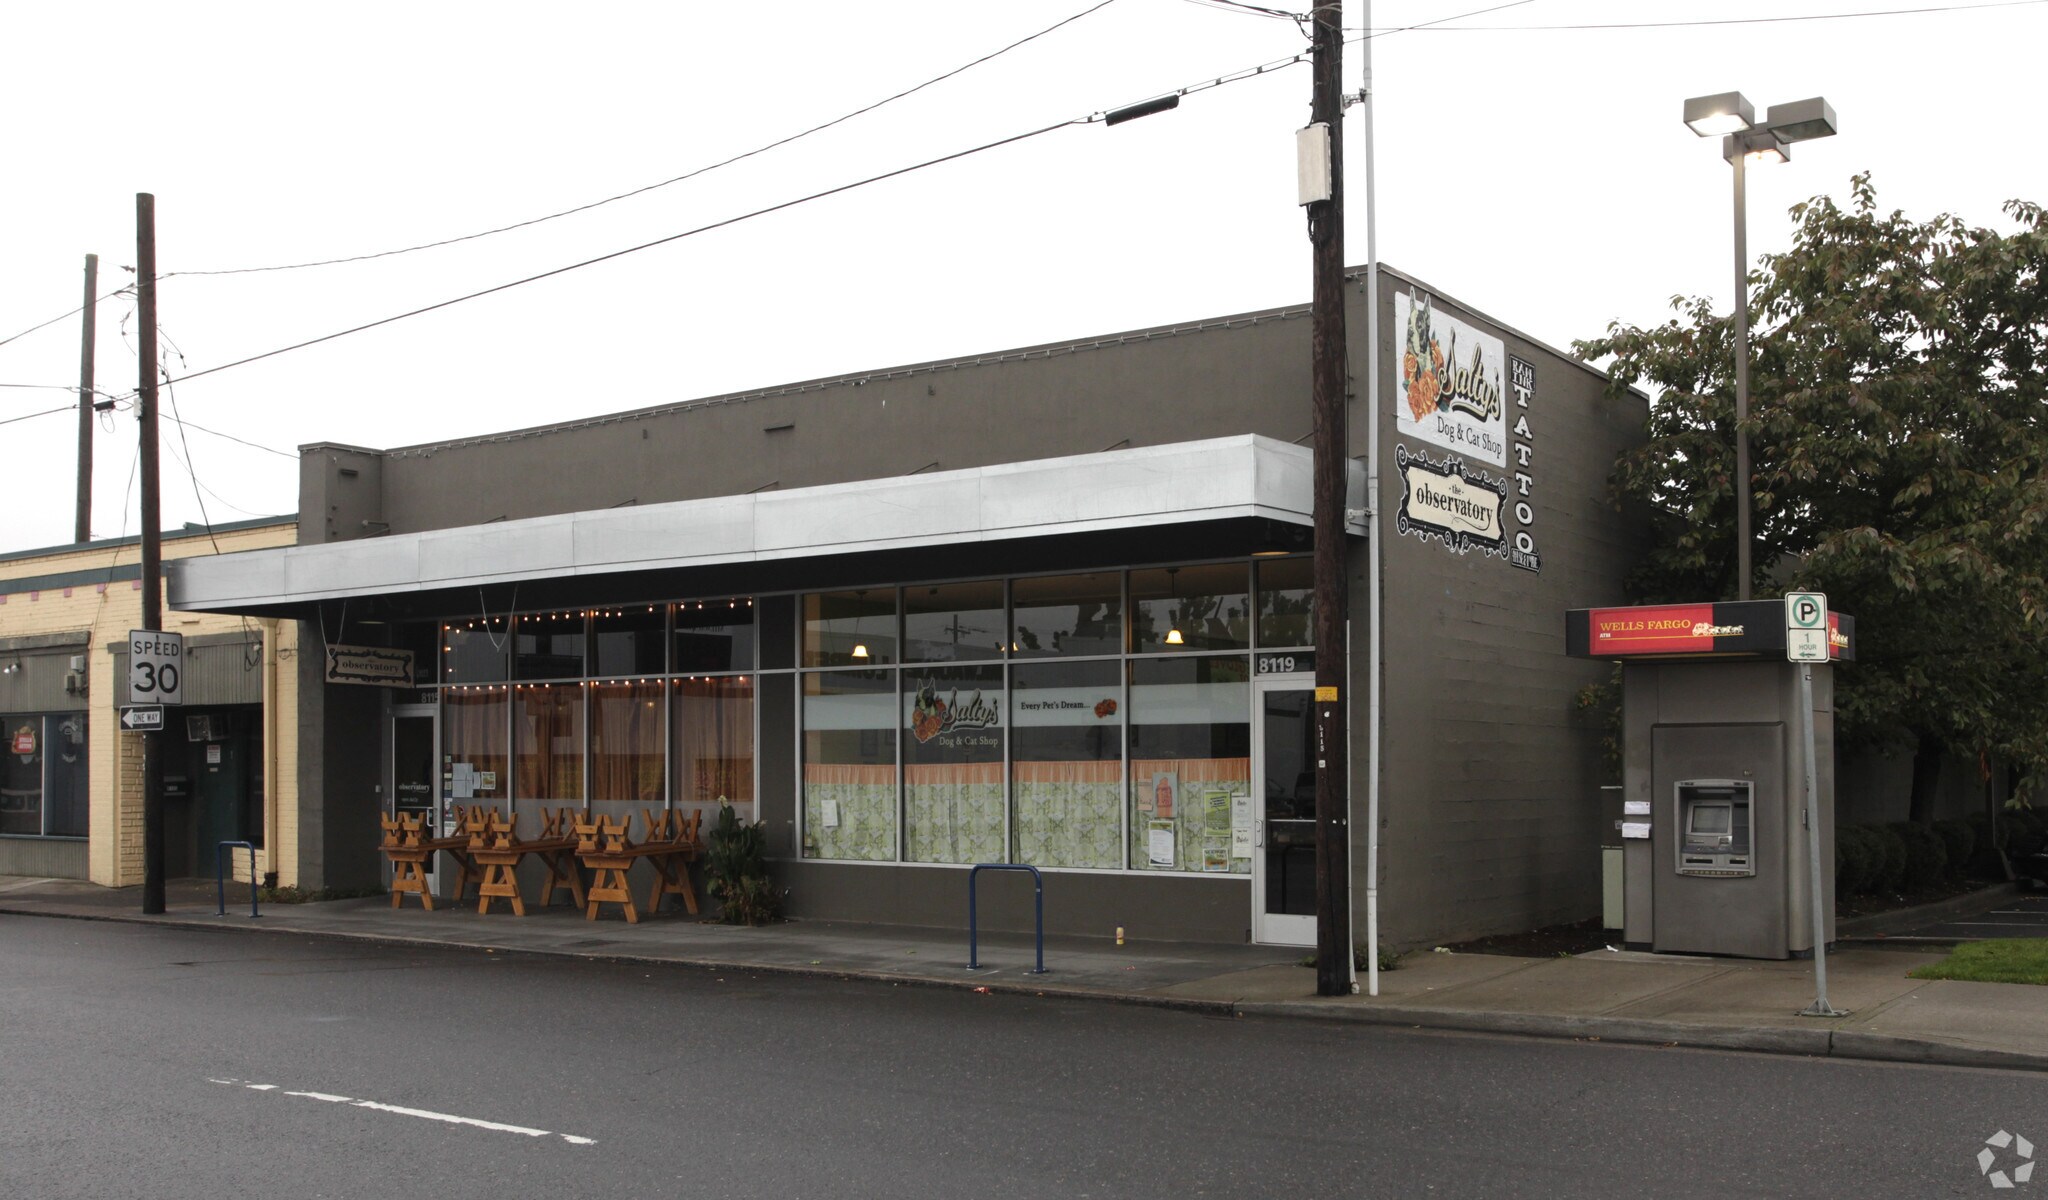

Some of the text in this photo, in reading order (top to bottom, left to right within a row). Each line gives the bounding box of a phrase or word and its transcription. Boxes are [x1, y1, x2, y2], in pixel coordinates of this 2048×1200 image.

[1436, 326, 1502, 423] Salty's
[1437, 416, 1502, 459] Dog & Cat Shop
[1514, 385, 1533, 554] TATTOO
[1416, 483, 1493, 523] observatory
[1801, 602, 1814, 621] P
[1600, 619, 1691, 631] WELLS FARGO
[1804, 632, 1810, 643] 1
[134, 640, 179, 656] SPEED
[342, 660, 400, 673] observatory
[1258, 656, 1295, 673] 8119
[134, 662, 178, 693] 30
[941, 687, 998, 728] Salty's
[1021, 701, 1040, 711] Every
[1042, 701, 1059, 710] Pet's
[133, 713, 159, 723] ONE WAY
[939, 735, 998, 747] Dog & Cat Shop
